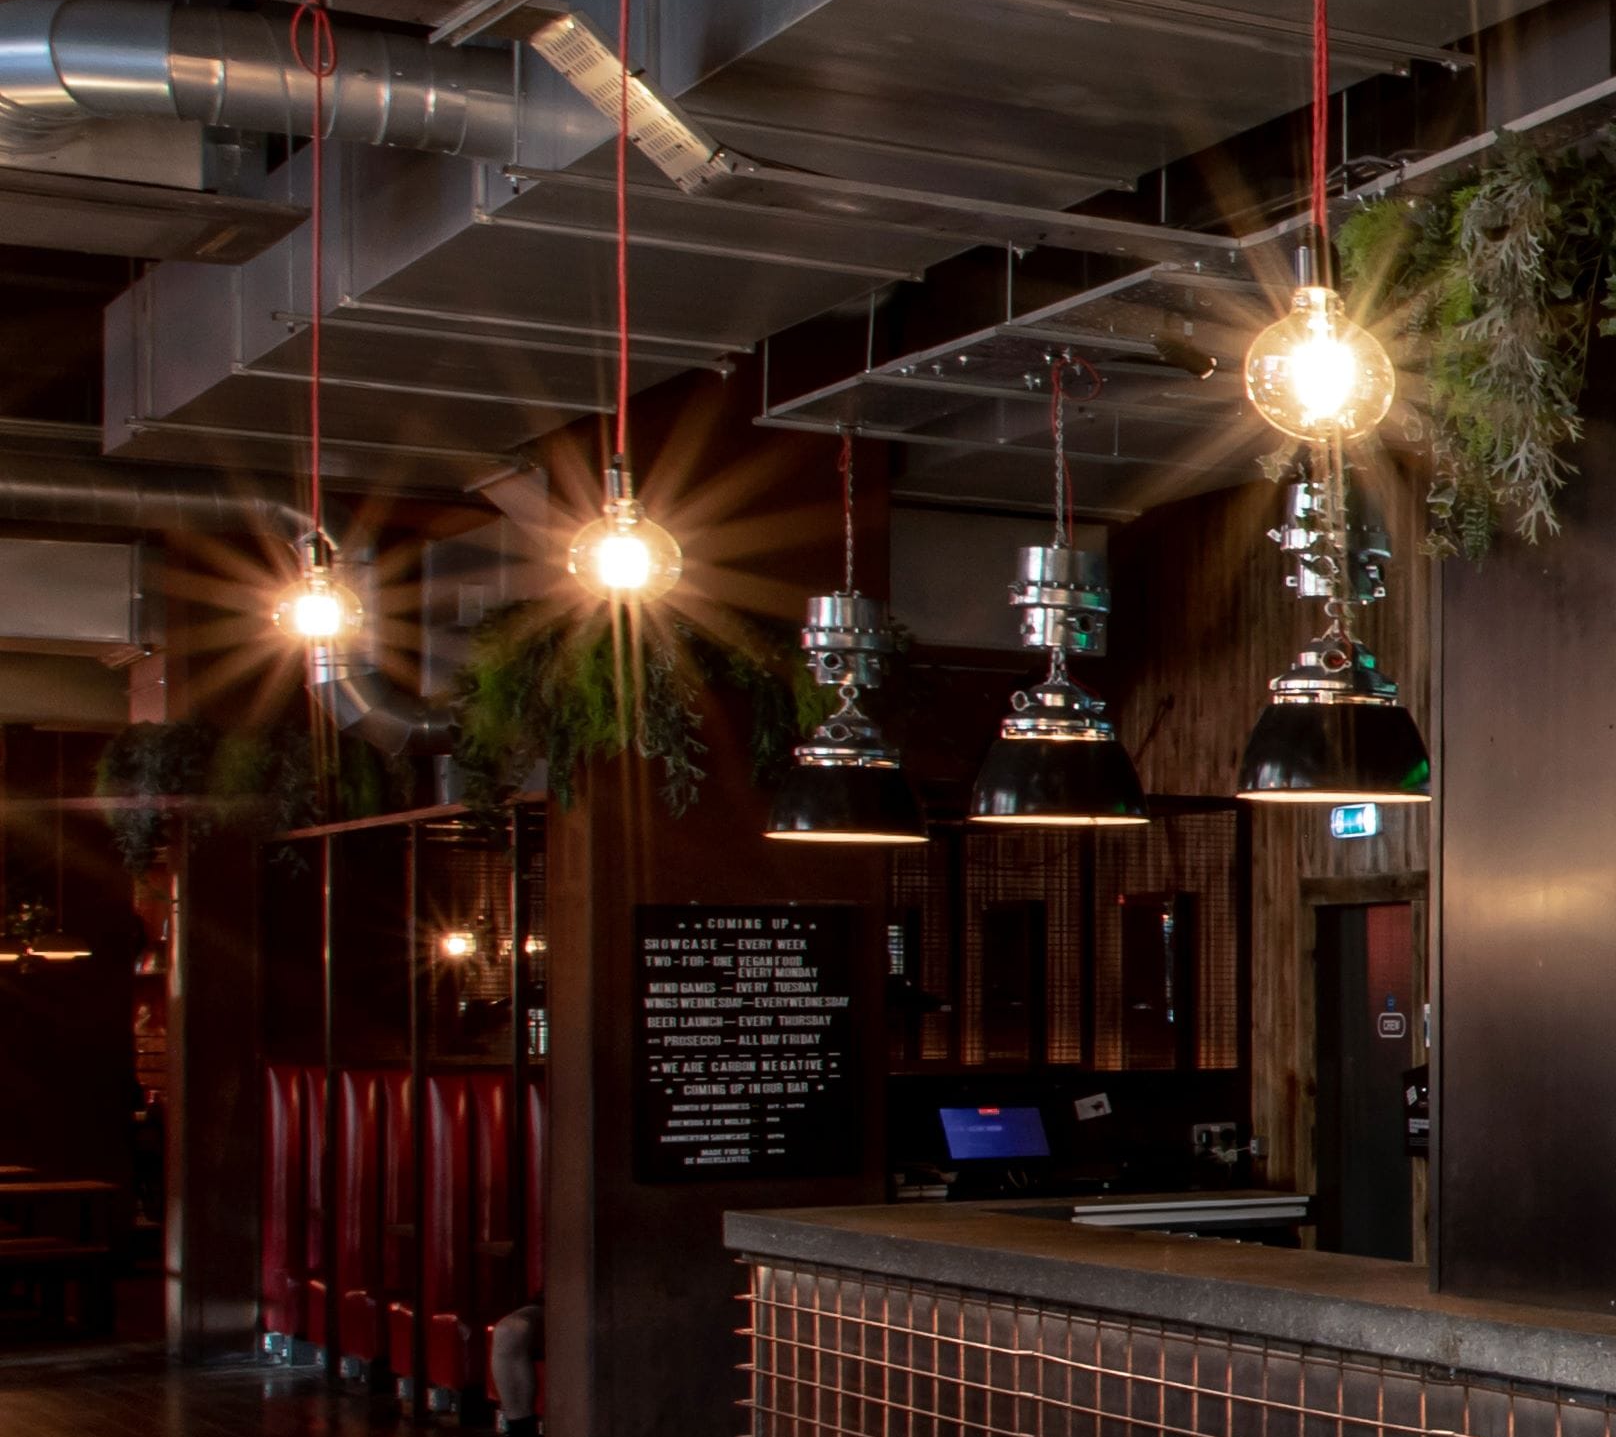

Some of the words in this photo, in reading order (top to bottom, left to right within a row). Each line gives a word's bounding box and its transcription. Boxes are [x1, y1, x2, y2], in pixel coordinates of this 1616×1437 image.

[707, 919, 762, 929] COMING
[772, 919, 789, 930] UP
[738, 939, 772, 950] EVERY
[776, 939, 807, 949] WEEK
